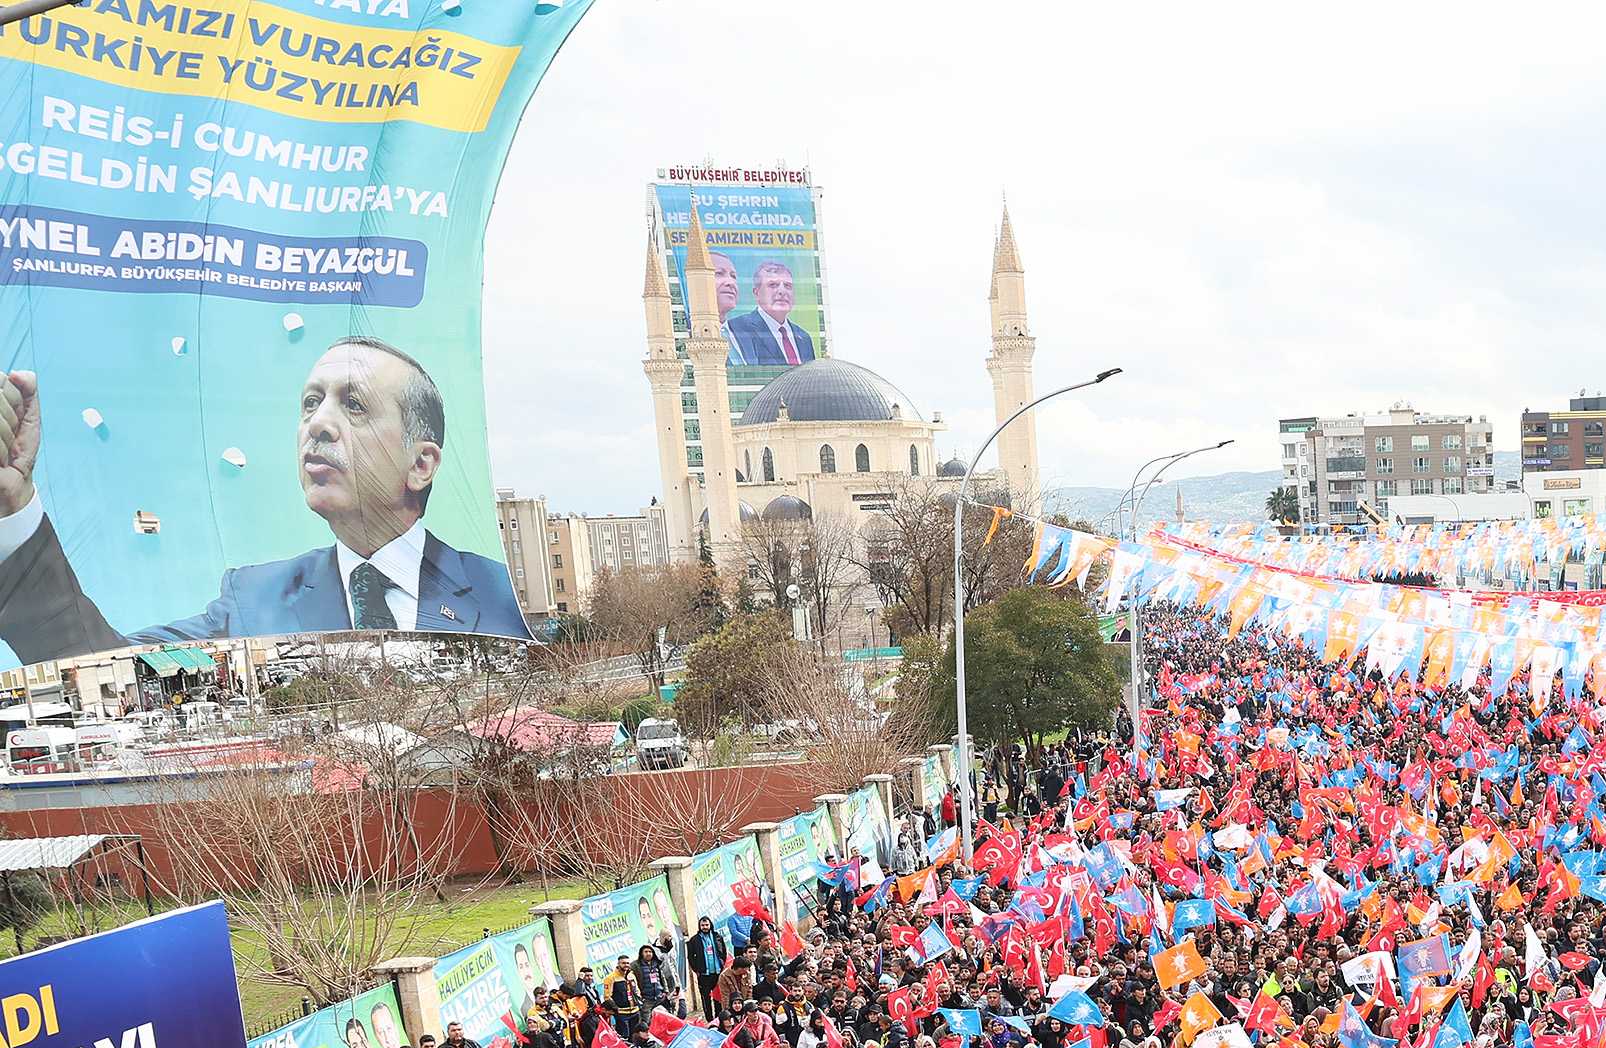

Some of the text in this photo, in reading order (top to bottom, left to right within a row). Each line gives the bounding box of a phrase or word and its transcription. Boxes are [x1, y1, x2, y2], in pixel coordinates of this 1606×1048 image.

[248, 18, 482, 79] VURACAĞIZ
[218, 55, 419, 108] YÜZYILINA
[43, 95, 369, 172] REİS-İ CUMHUR
[669, 165, 806, 183] BÜYÜKŞEHİR BELEDİYESİ
[665, 211, 805, 226] HE SOKAĞINDA
[718, 195, 779, 209] ŞEHRİN
[110, 229, 244, 267] ABİDİN
[255, 243, 415, 276] BEYAZGÜL
[777, 233, 804, 245] VAR
[12, 257, 362, 293] ŞANLIURFA BÜYÜKŞEHİR BELEDİYE BAŞKANI
